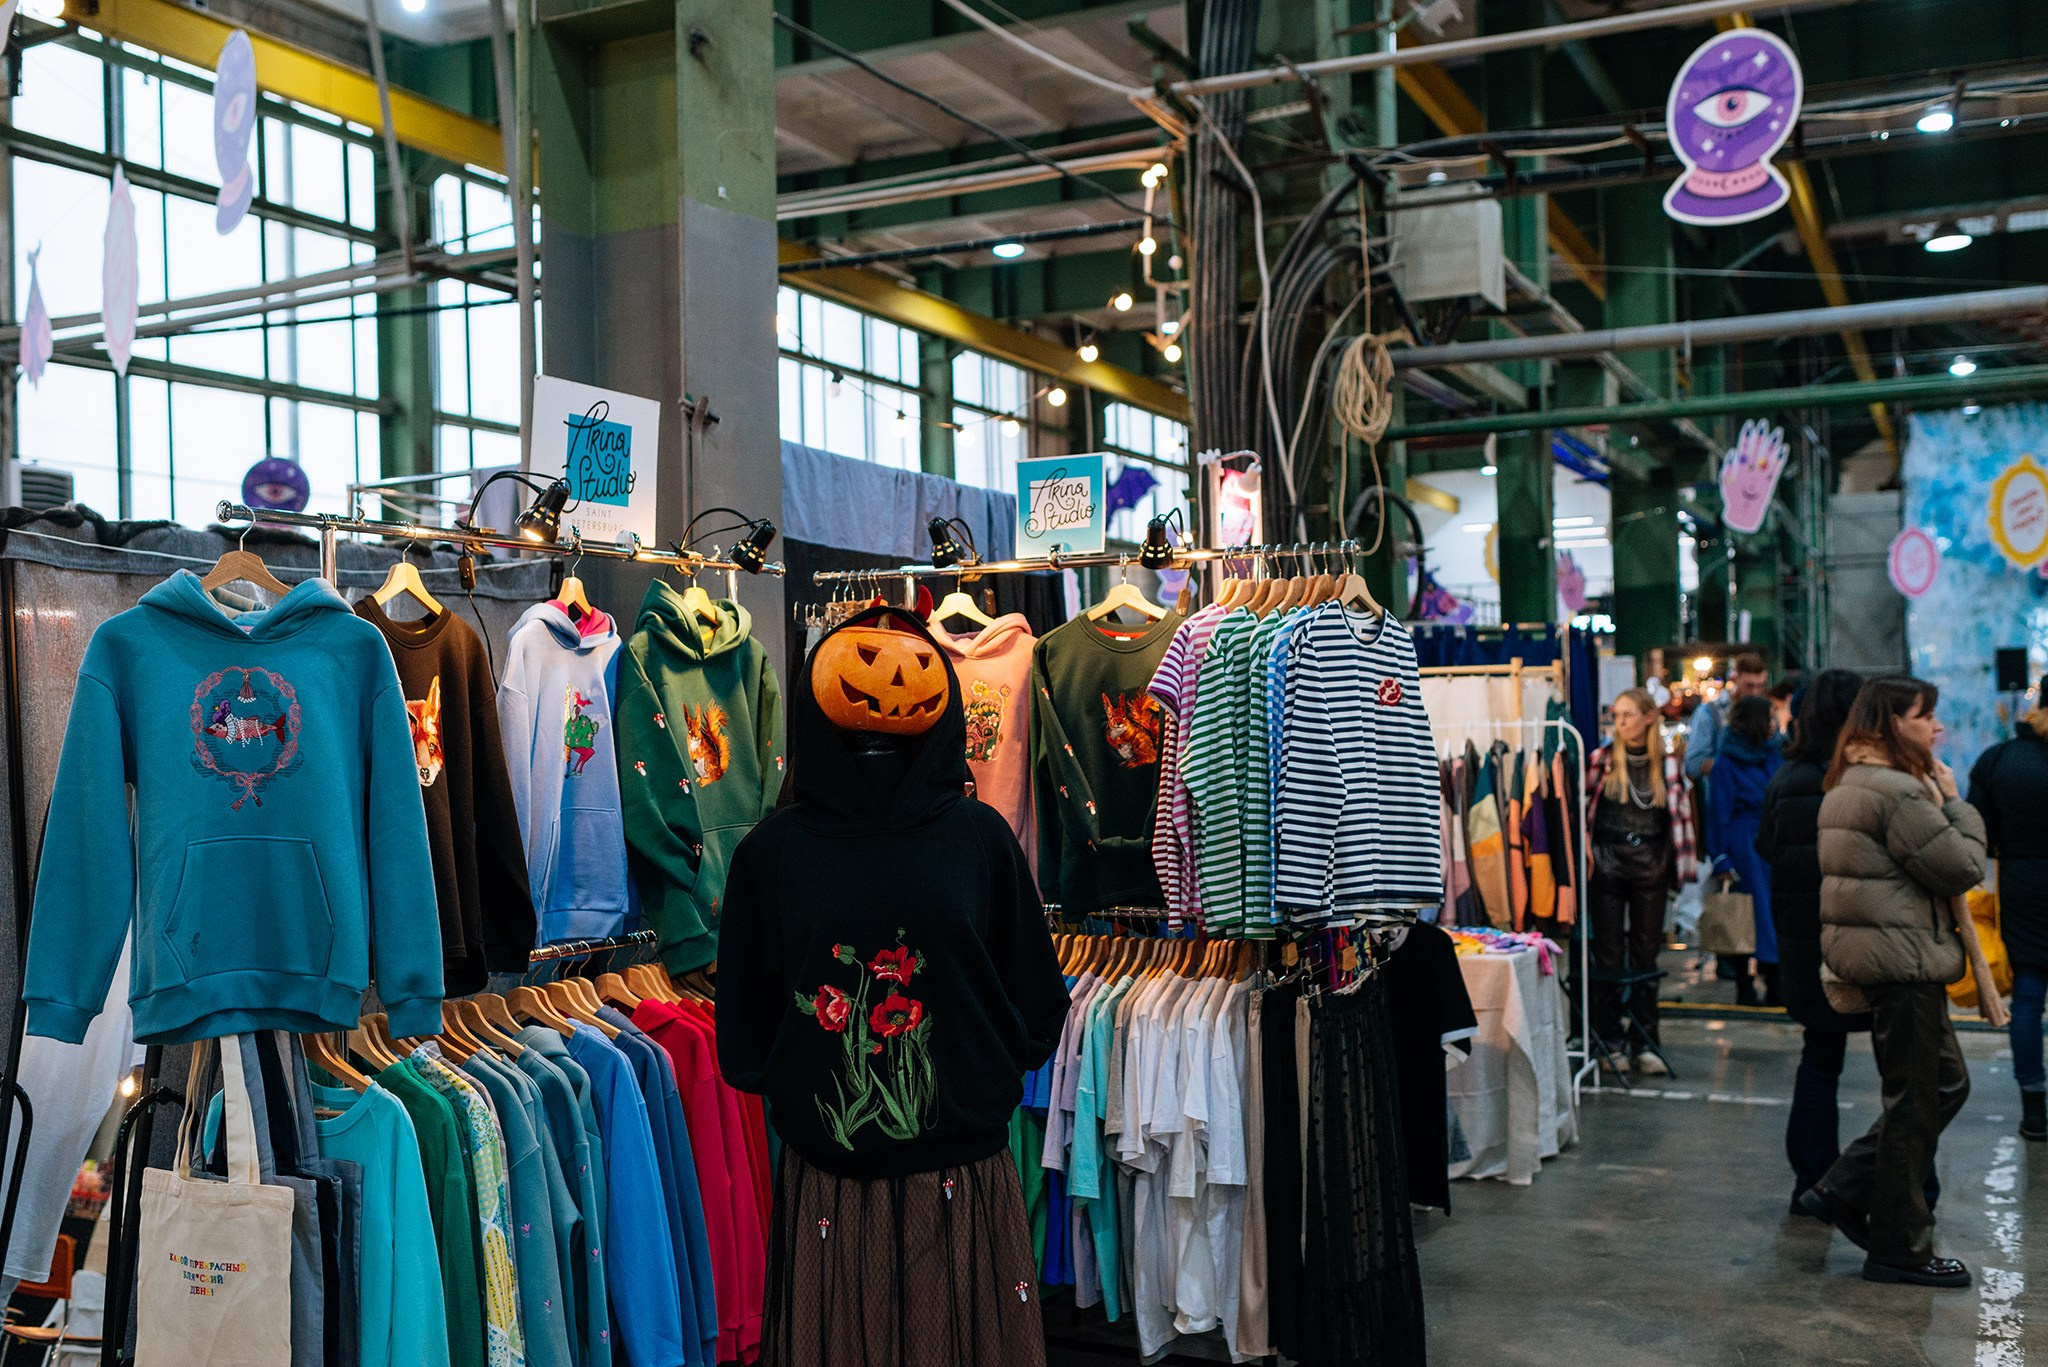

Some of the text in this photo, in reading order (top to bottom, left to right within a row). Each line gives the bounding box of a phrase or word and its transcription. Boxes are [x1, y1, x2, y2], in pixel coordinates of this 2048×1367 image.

[560, 455, 637, 513] Studio
[586, 507, 611, 518] SAINT
[1024, 499, 1096, 539] Studio
[189, 1259, 246, 1272] ПРЕКРАСНЫЙ
[190, 1285, 214, 1296] ДЕНЬ!
